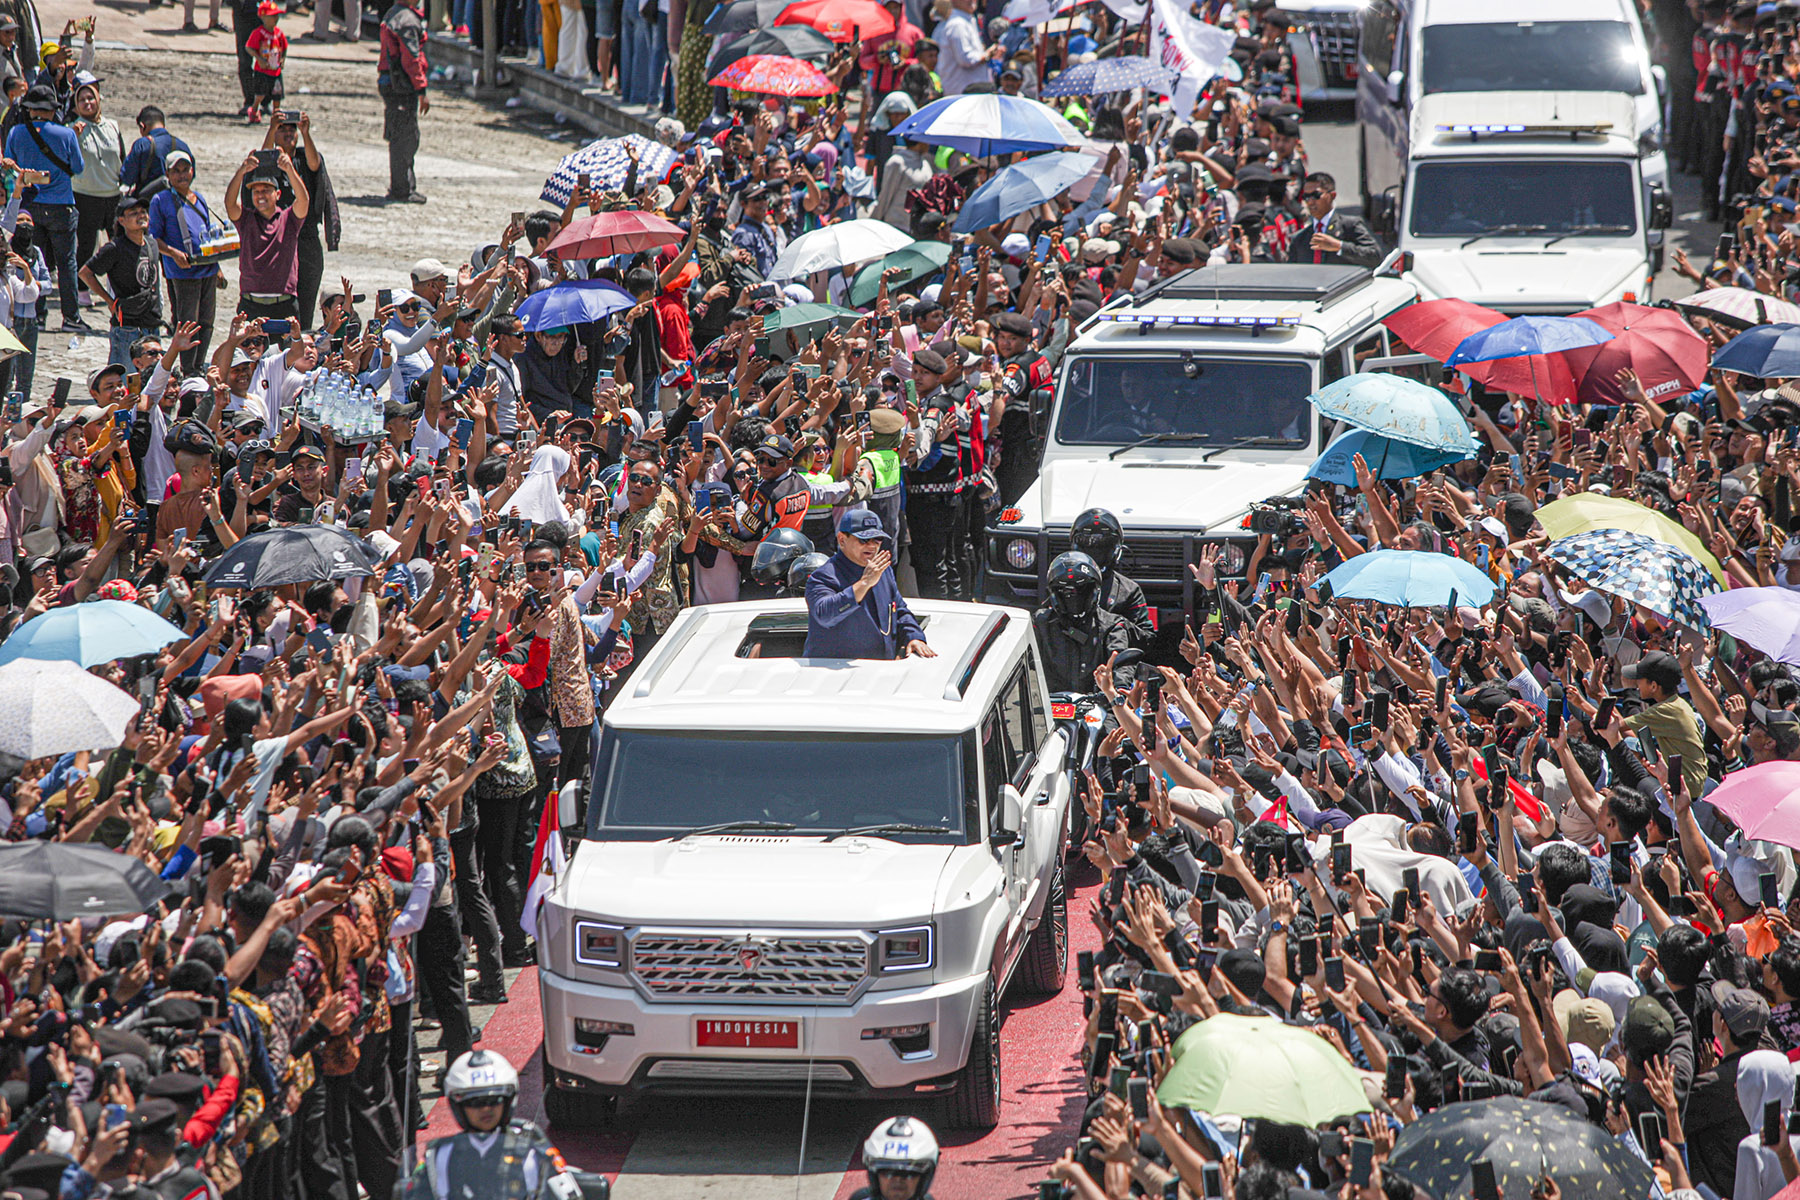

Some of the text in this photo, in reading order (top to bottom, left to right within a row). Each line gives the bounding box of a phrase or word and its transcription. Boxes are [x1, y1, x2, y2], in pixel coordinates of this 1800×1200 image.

[1653, 379, 1681, 397] YPPH
[706, 1022, 789, 1035] INDONESIA
[745, 1035, 750, 1047] 1
[884, 1141, 909, 1158] PM
